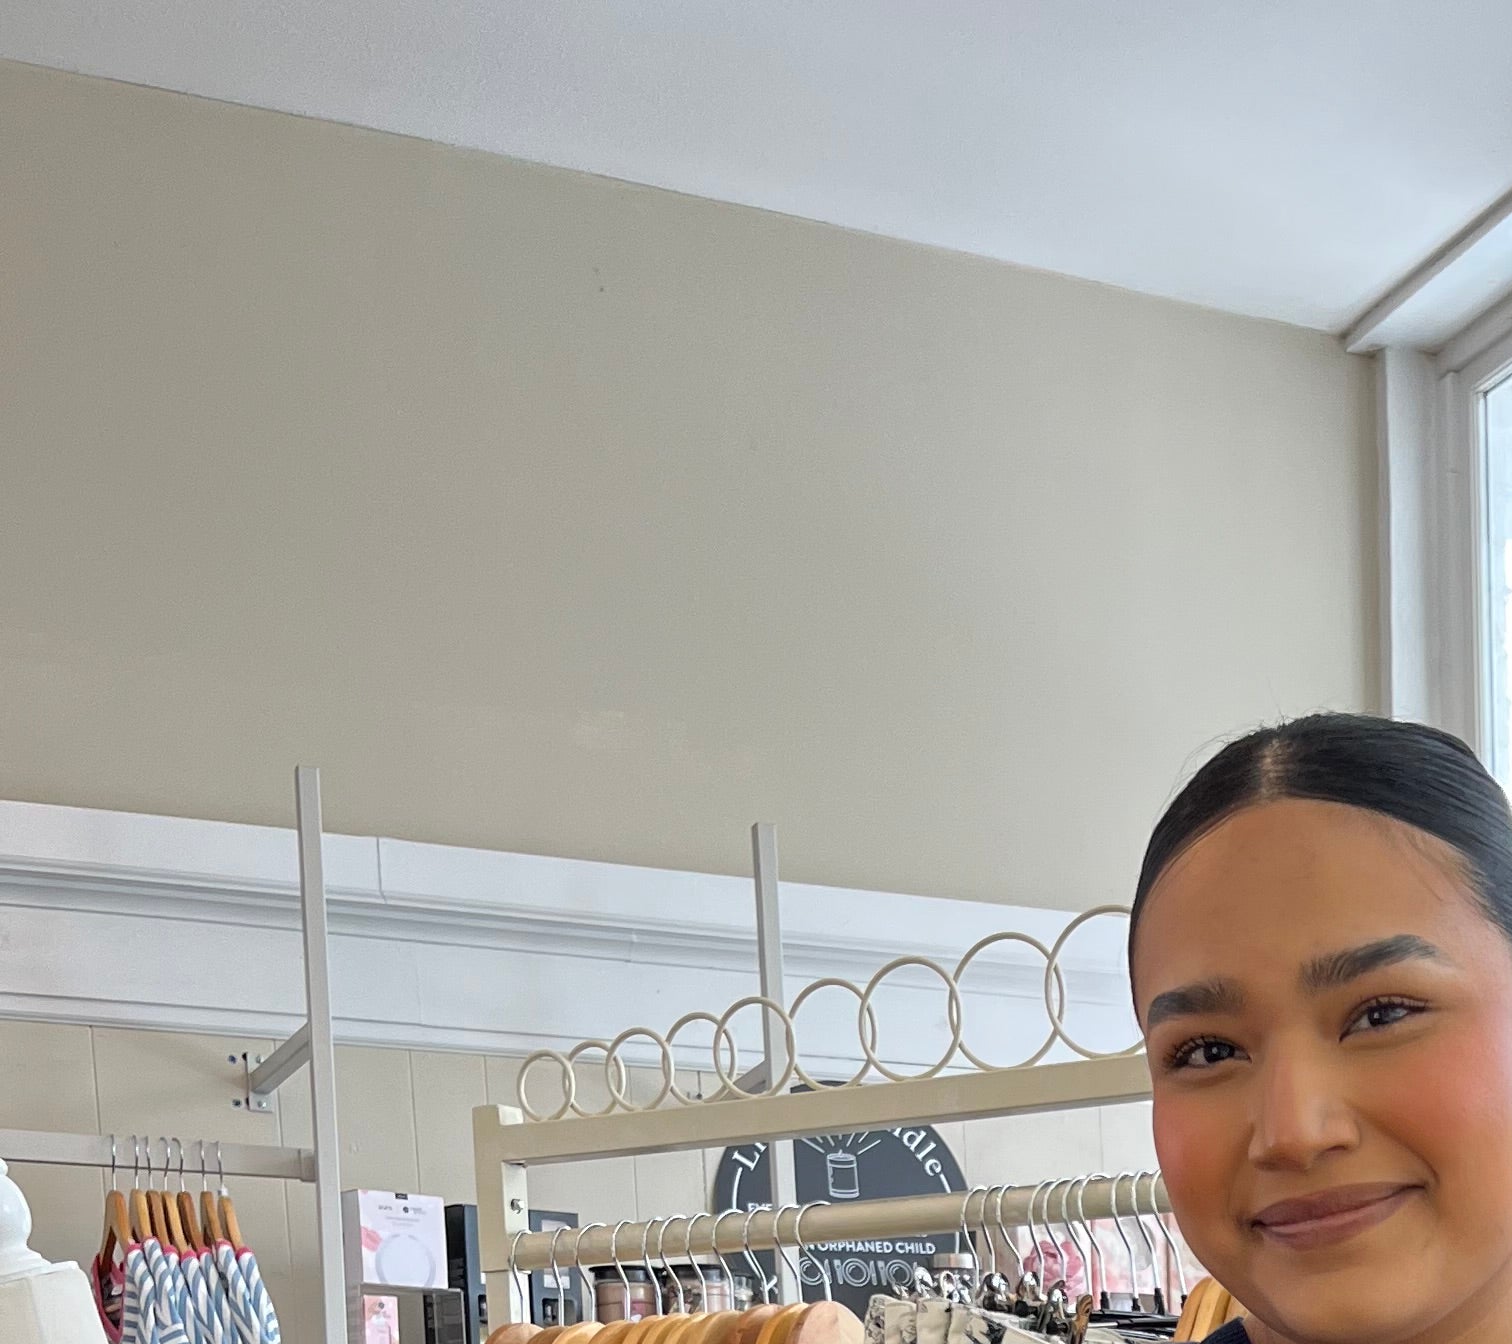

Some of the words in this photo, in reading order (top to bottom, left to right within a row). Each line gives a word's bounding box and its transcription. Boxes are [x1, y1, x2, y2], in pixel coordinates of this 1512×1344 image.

[888, 1127, 942, 1177] dle
[817, 1241, 893, 1254] ORPHANED
[895, 1242, 936, 1255] CHILD
